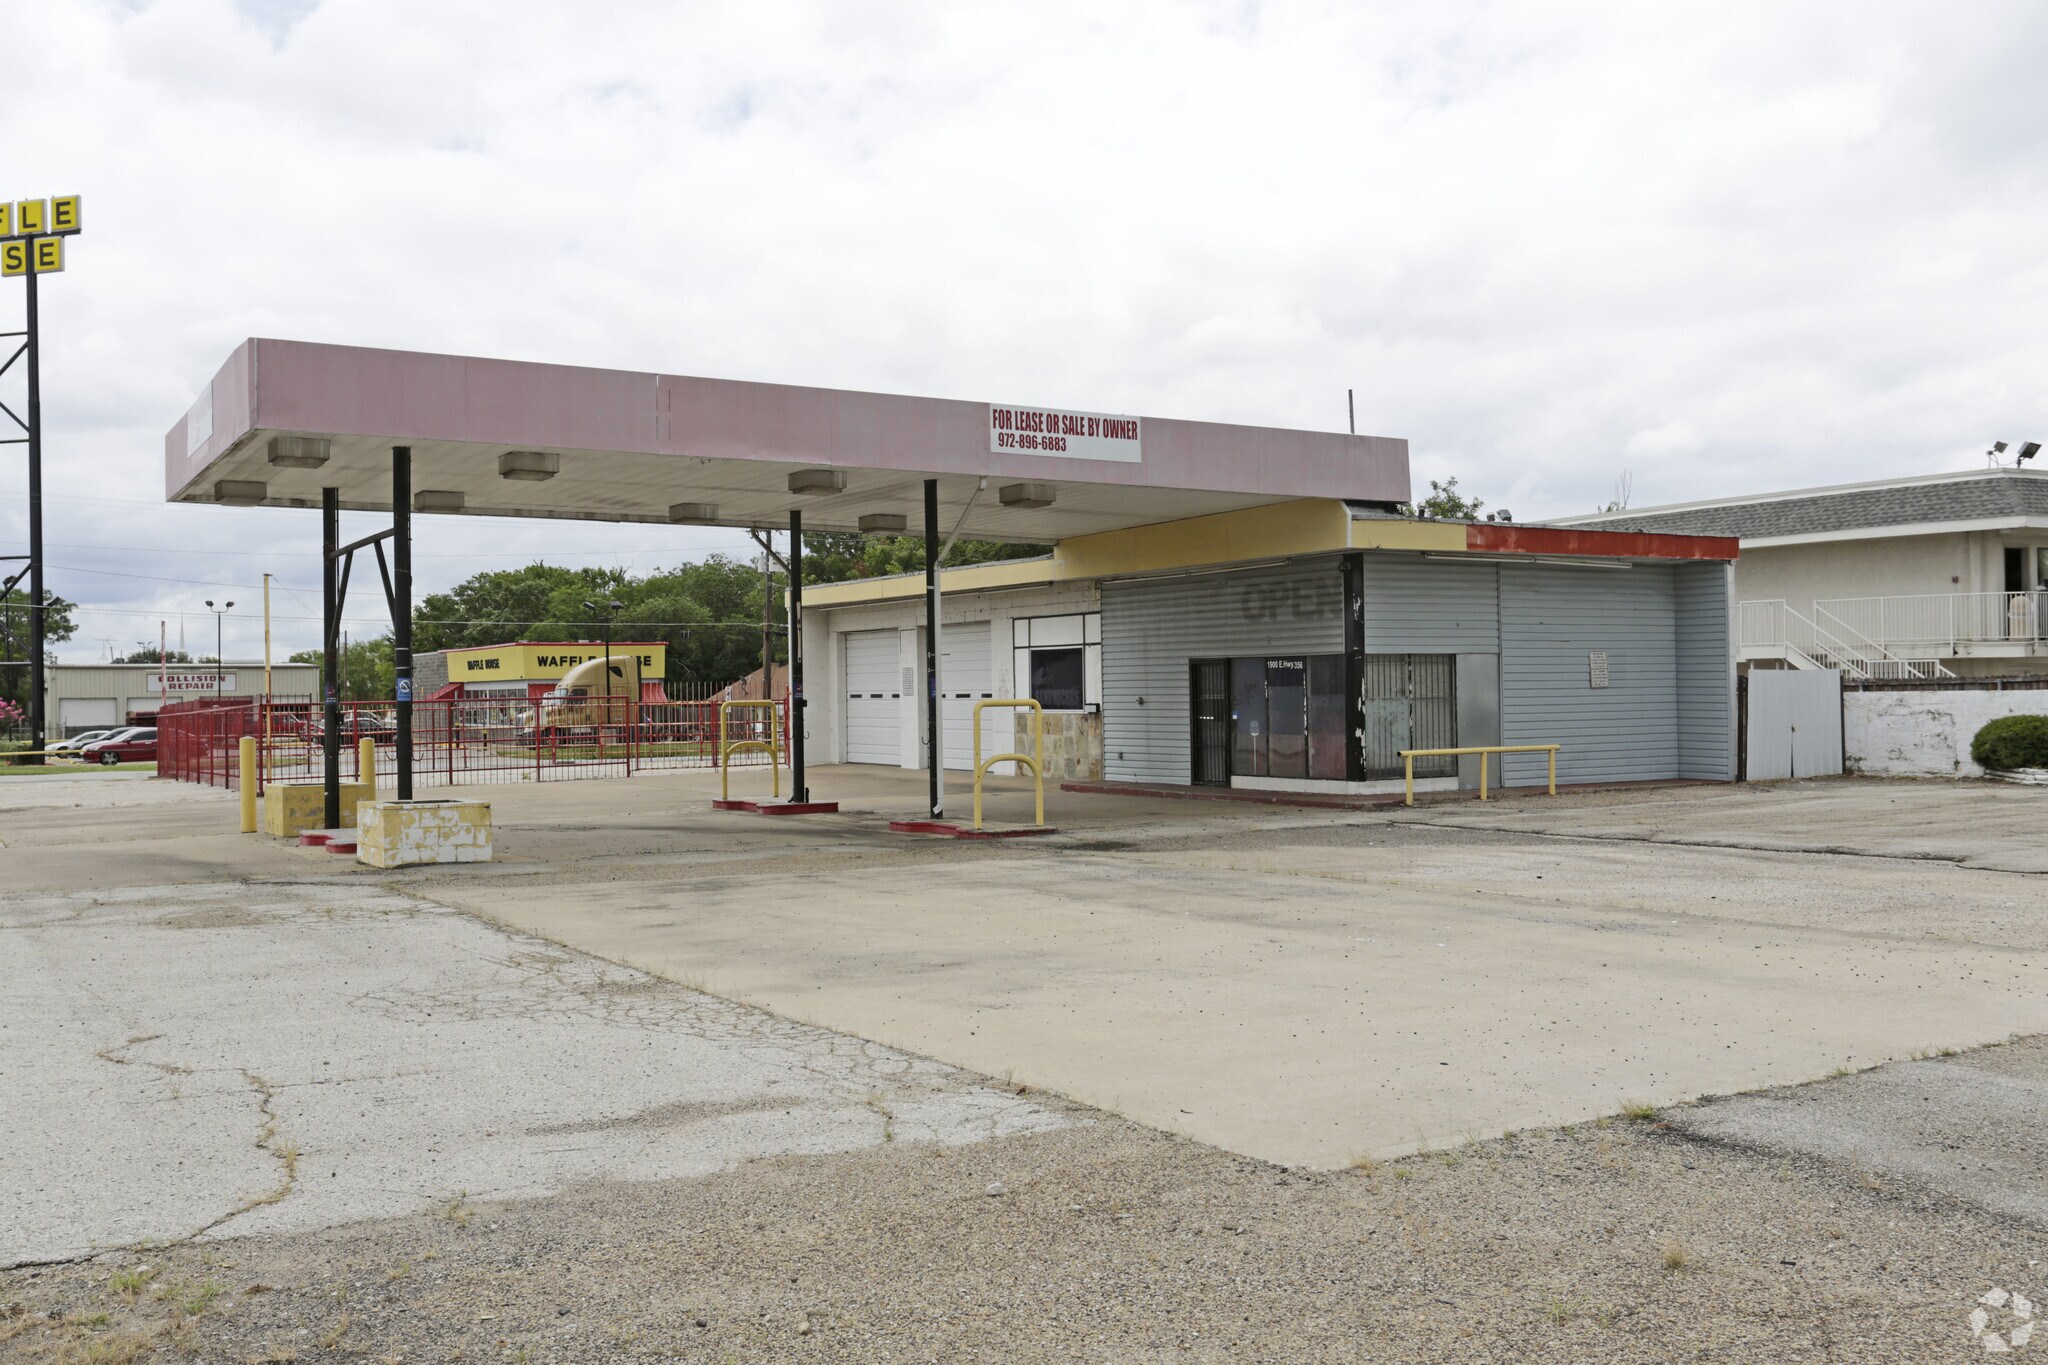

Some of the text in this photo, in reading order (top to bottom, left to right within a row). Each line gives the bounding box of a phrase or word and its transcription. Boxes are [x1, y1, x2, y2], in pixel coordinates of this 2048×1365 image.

[0, 201, 71, 229] LE
[6, 242, 55, 270] SE
[993, 408, 1138, 440] FOR LEASE OR SALE BY OWNER
[998, 432, 1067, 452] 972-896-6883
[467, 660, 484, 671] WAFFLE
[168, 682, 214, 690] REPAIR
